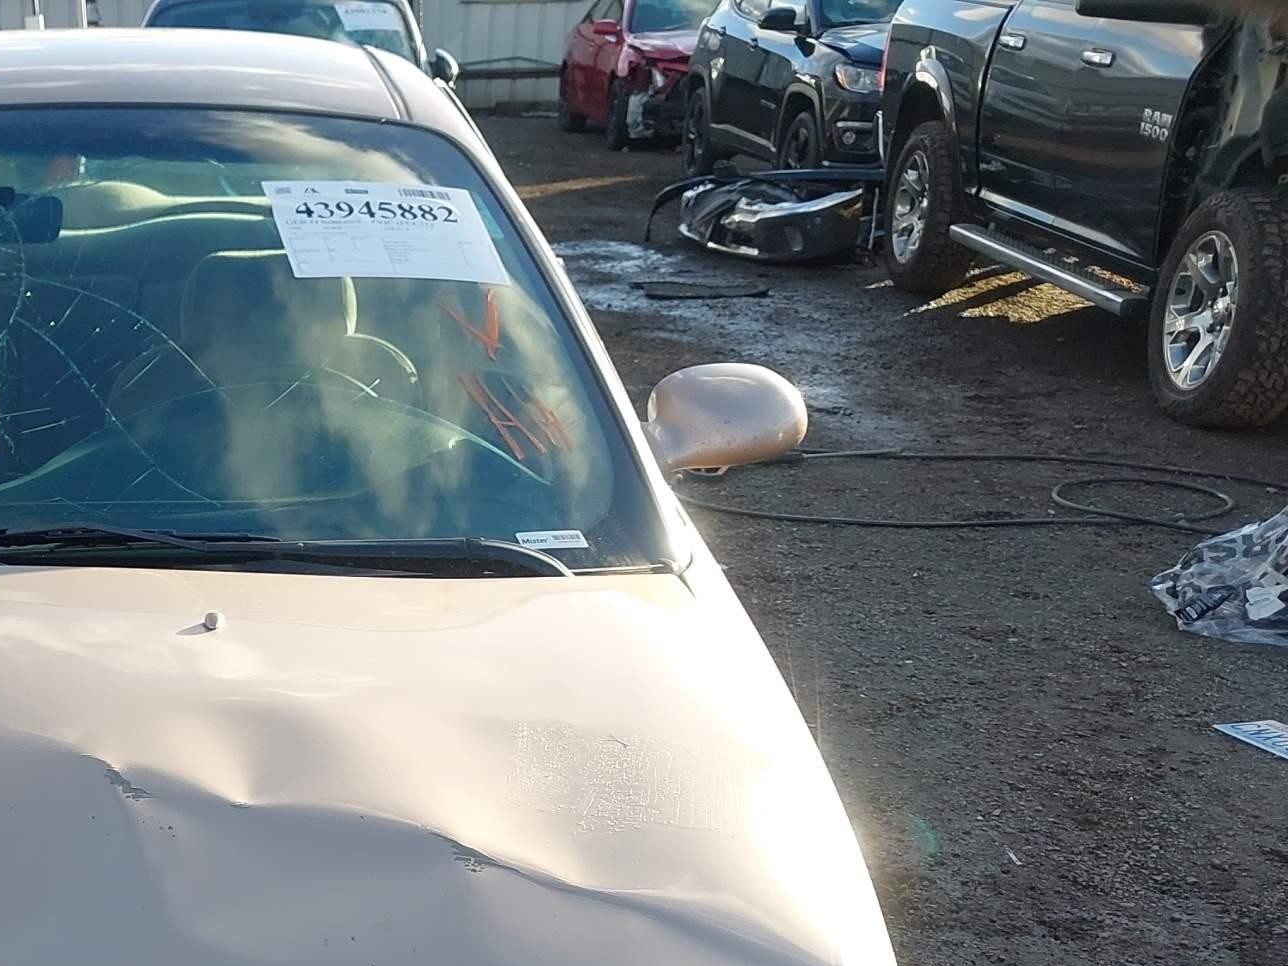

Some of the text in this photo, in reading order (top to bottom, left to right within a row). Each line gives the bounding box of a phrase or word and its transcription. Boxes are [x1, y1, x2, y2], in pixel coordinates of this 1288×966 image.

[1143, 108, 1173, 127] RAM
[1140, 121, 1169, 140] 1500
[295, 201, 458, 223] 43945882
